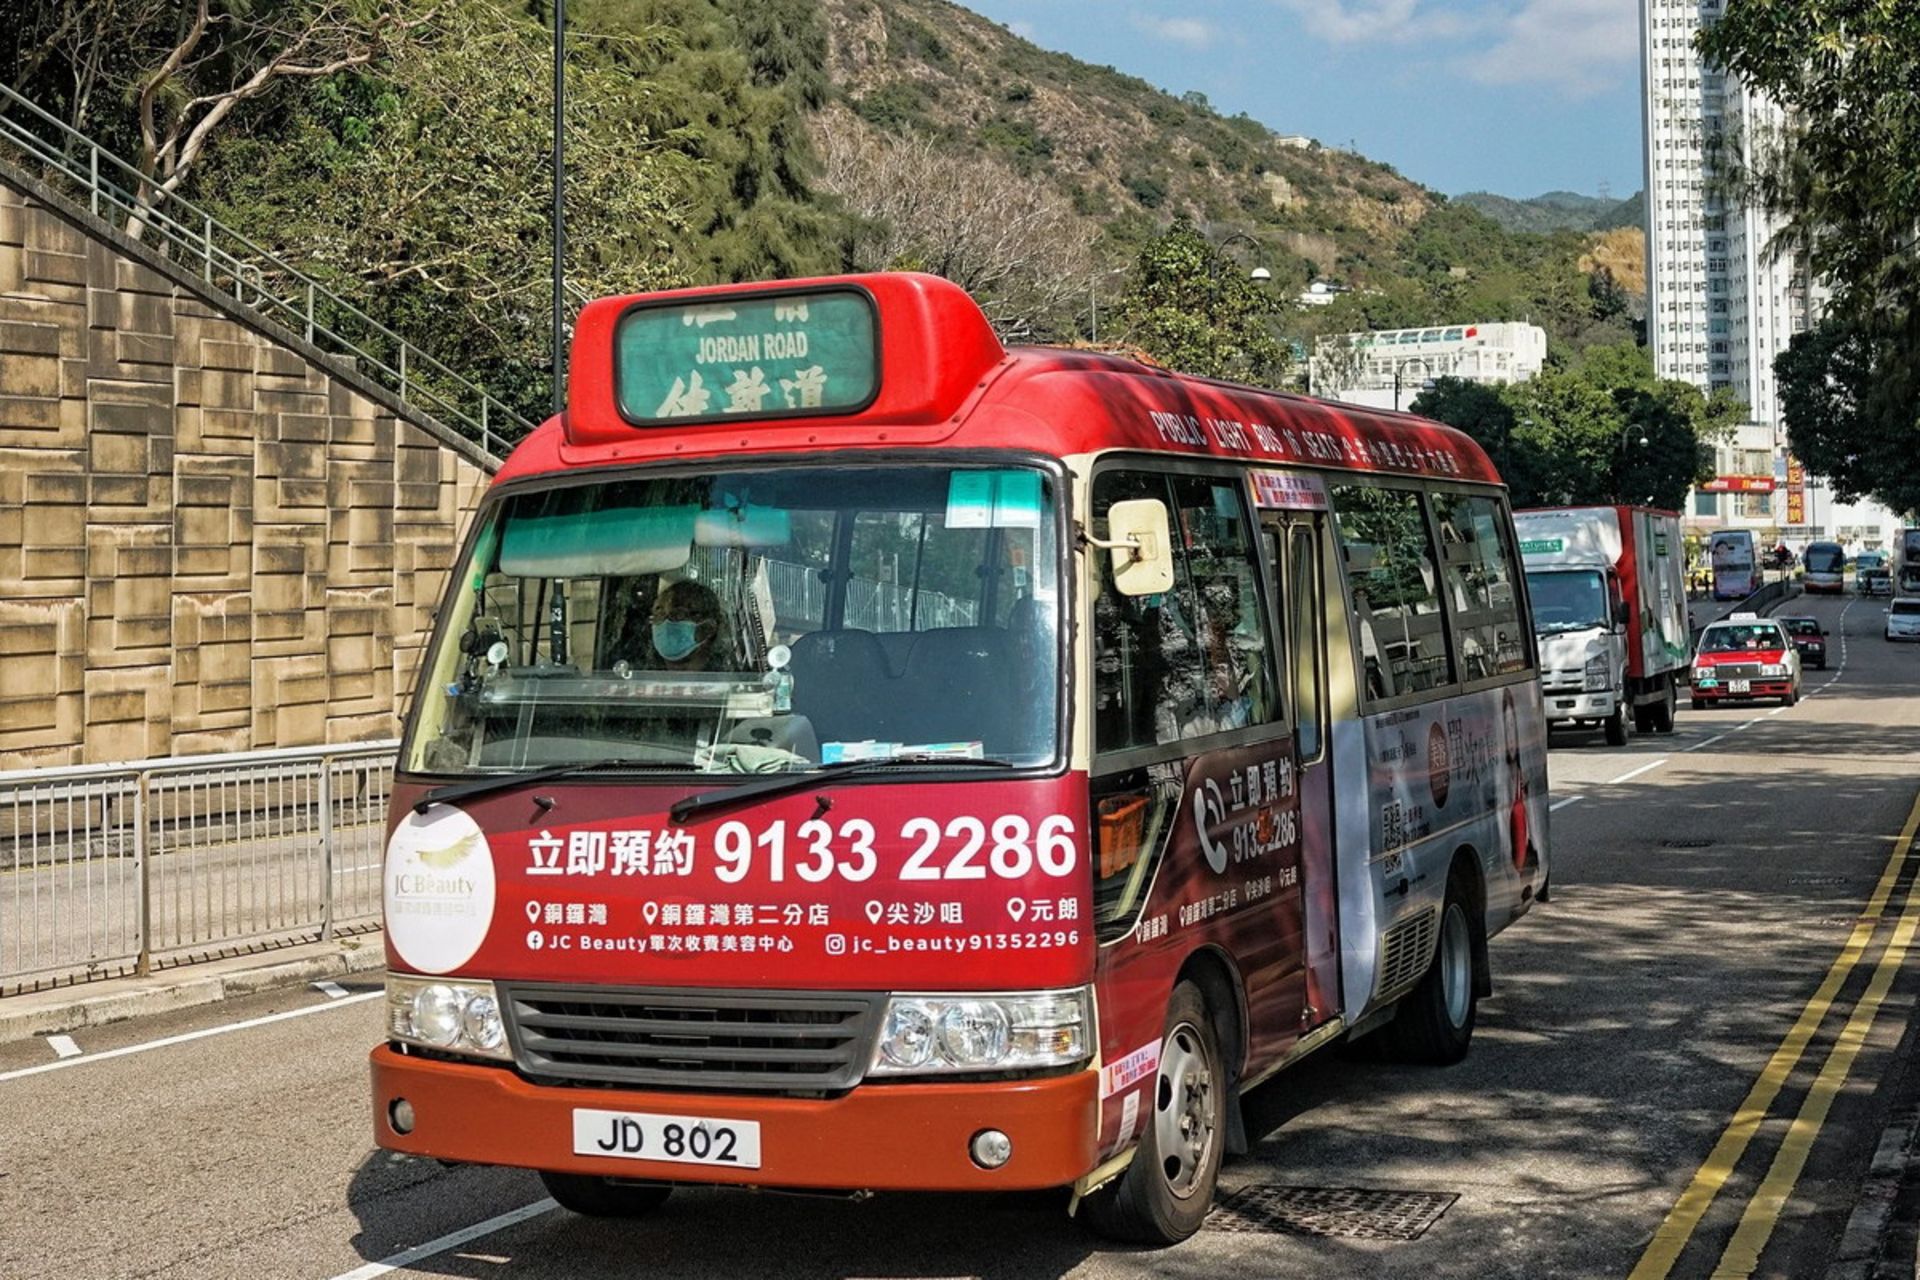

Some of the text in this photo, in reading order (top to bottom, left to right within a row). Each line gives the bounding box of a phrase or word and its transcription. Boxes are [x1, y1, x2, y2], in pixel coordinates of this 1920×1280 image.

[695, 331, 808, 364] JORDAN ROAD
[1150, 410, 1208, 446] PUBLIC
[1206, 417, 1252, 450] LIGHT
[1251, 423, 1284, 454] BUS
[1282, 428, 1302, 456] 16
[1301, 431, 1343, 461] SEATS
[525, 815, 1077, 884] 立即預約 9133 2286
[1233, 822, 1265, 864] 913
[544, 897, 1079, 926] 銅鑼灣 銅鑼灣第二分店 尖沙咀 元朗
[549, 935, 571, 950] JC
[852, 930, 1080, 955] jc_beauty91352296
[598, 1119, 738, 1162] JD 802
